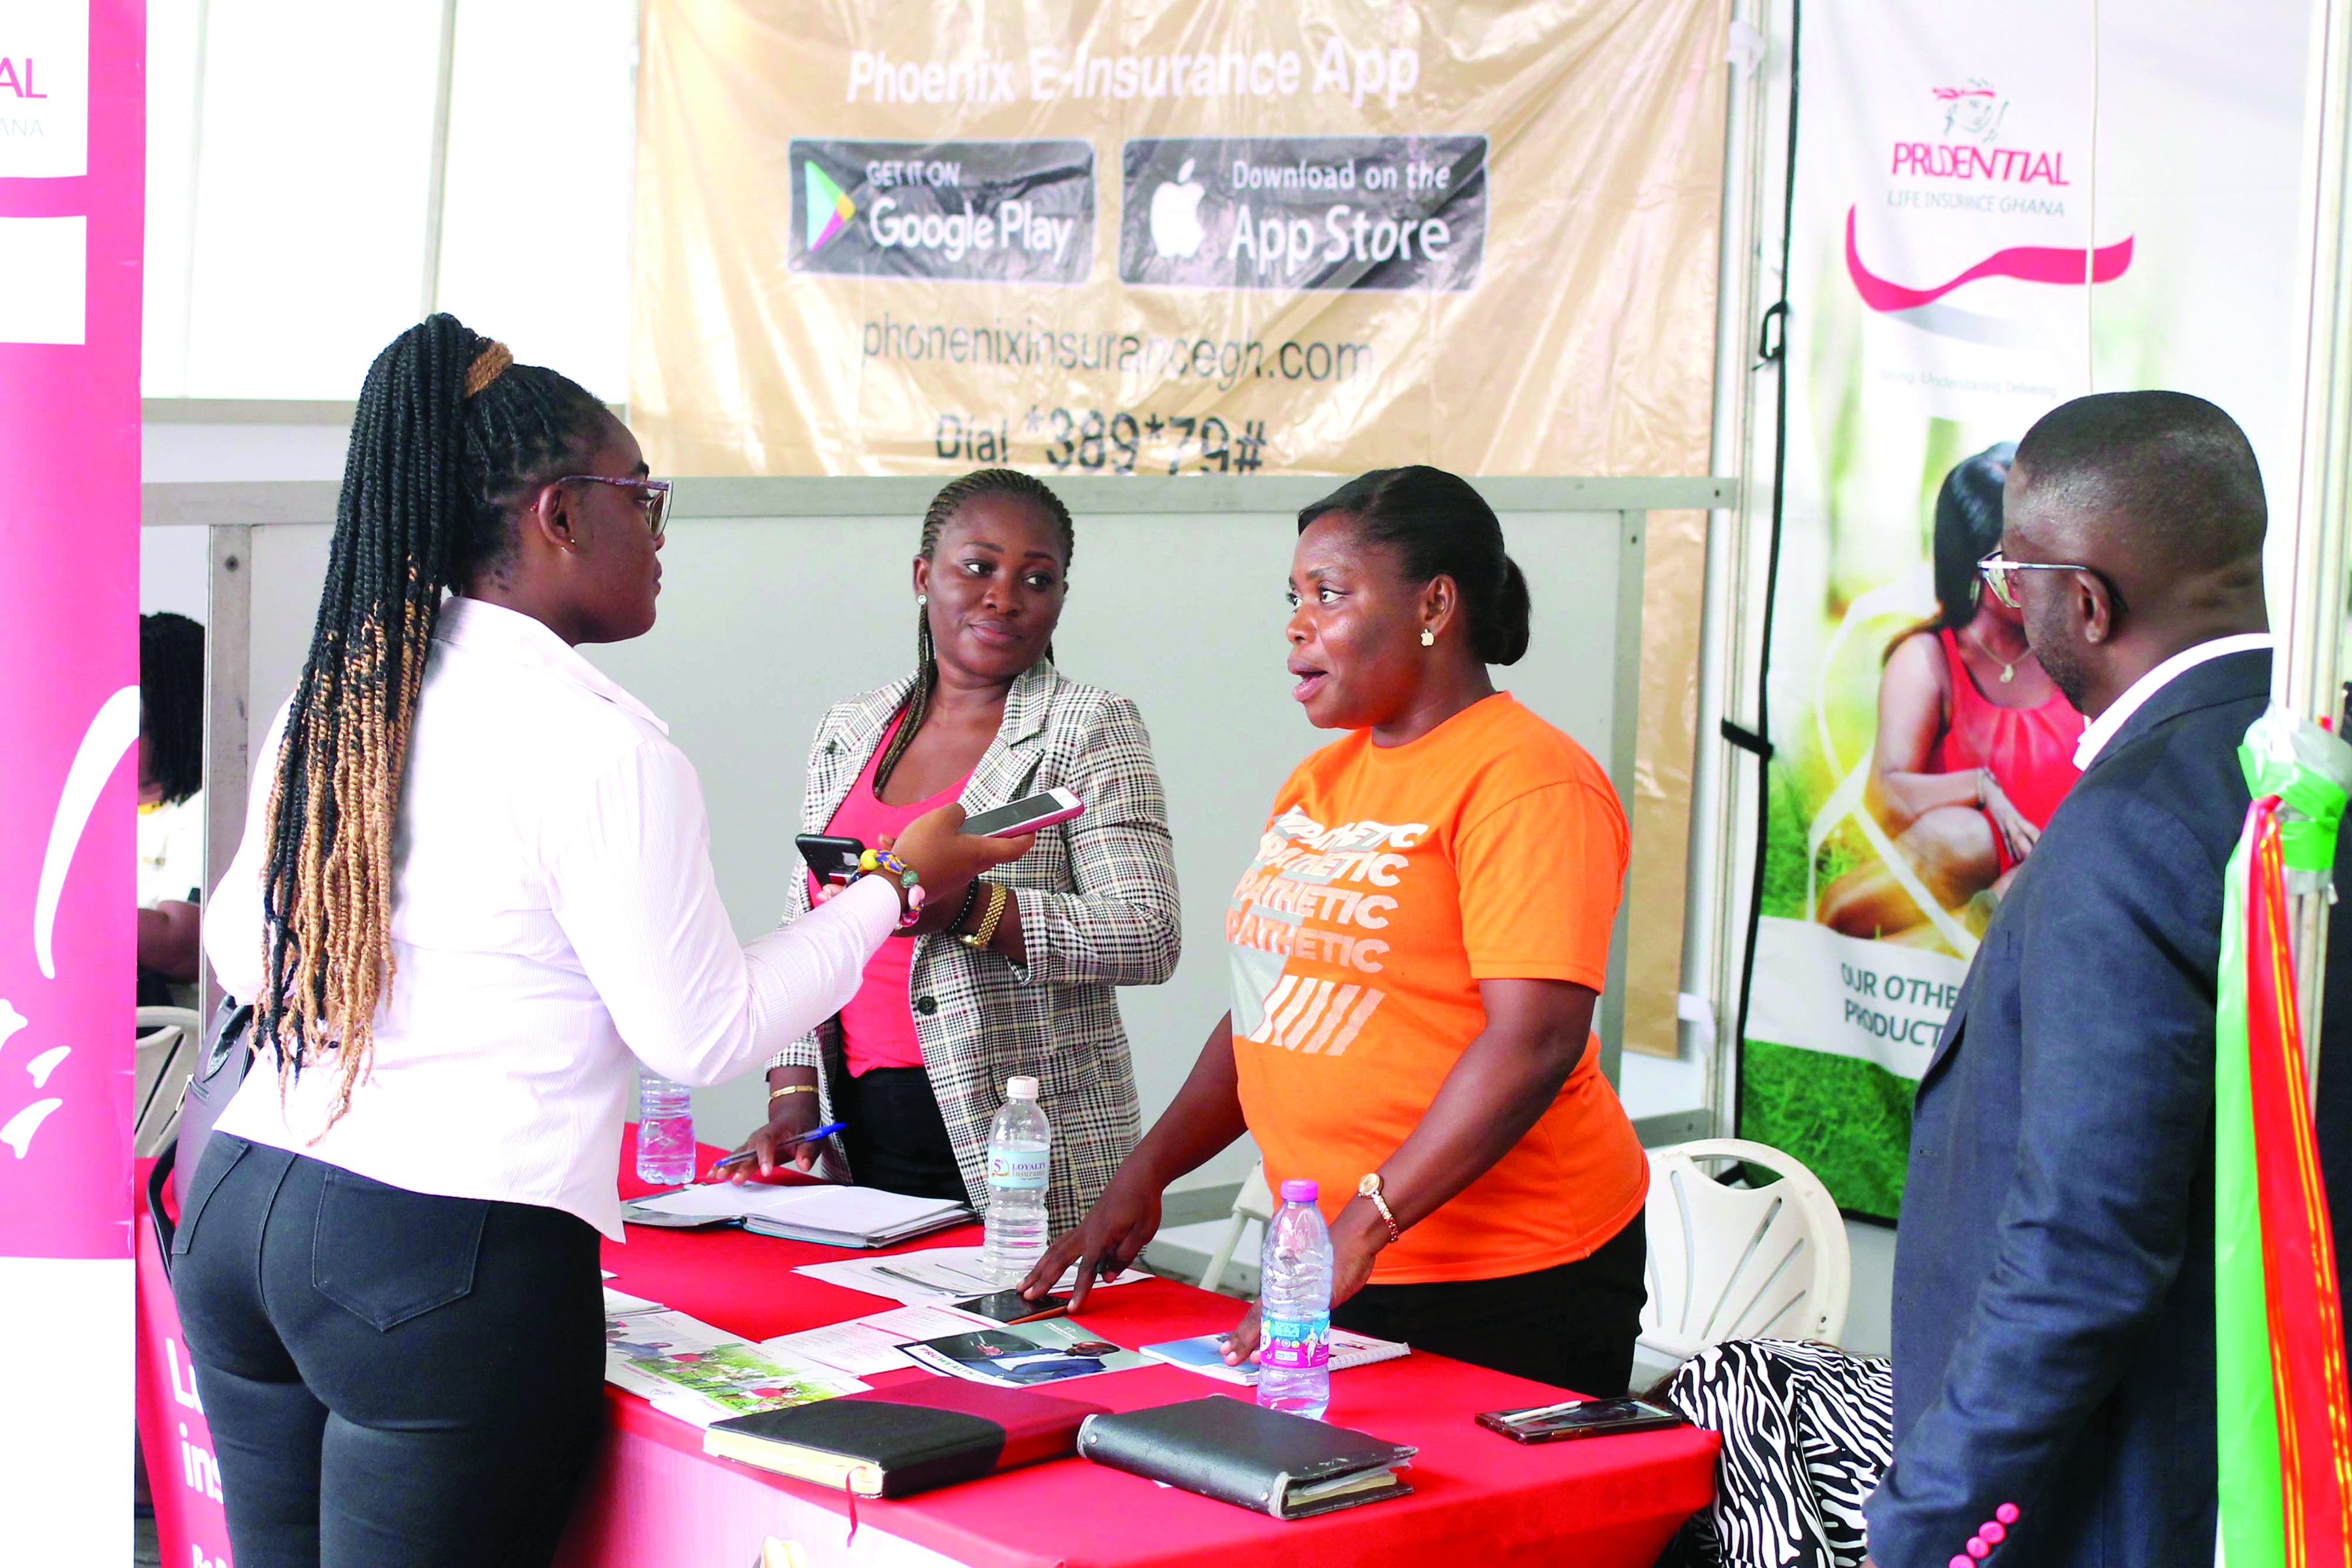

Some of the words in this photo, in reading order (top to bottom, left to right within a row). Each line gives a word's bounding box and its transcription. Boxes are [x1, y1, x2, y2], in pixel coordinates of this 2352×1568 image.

[846, 49, 1016, 104] Phoenix
[1028, 45, 1301, 101] E-Insurance
[1311, 35, 1420, 110] App
[866, 159, 904, 186] GET
[906, 161, 924, 186] IT
[926, 160, 961, 188] ON
[1232, 158, 1356, 190] Download
[1365, 166, 1398, 190] on
[1406, 159, 1451, 190] the
[1892, 142, 2070, 186] PRUDENTIAL
[870, 196, 994, 262] Google
[1000, 199, 1075, 264] Play
[1887, 189, 1920, 206] LIFE
[2000, 195, 2065, 217] GHANA
[1227, 204, 1315, 277] App
[1323, 204, 1451, 263] Store
[861, 310, 1373, 392] phonenixinsurancegh.com
[936, 413, 1008, 463] Dial
[1232, 868, 1399, 930] PATHETIC
[1224, 907, 1391, 973] PATHETIC
[1841, 962, 1876, 998] OUR
[1885, 975, 1959, 1009] OTHE
